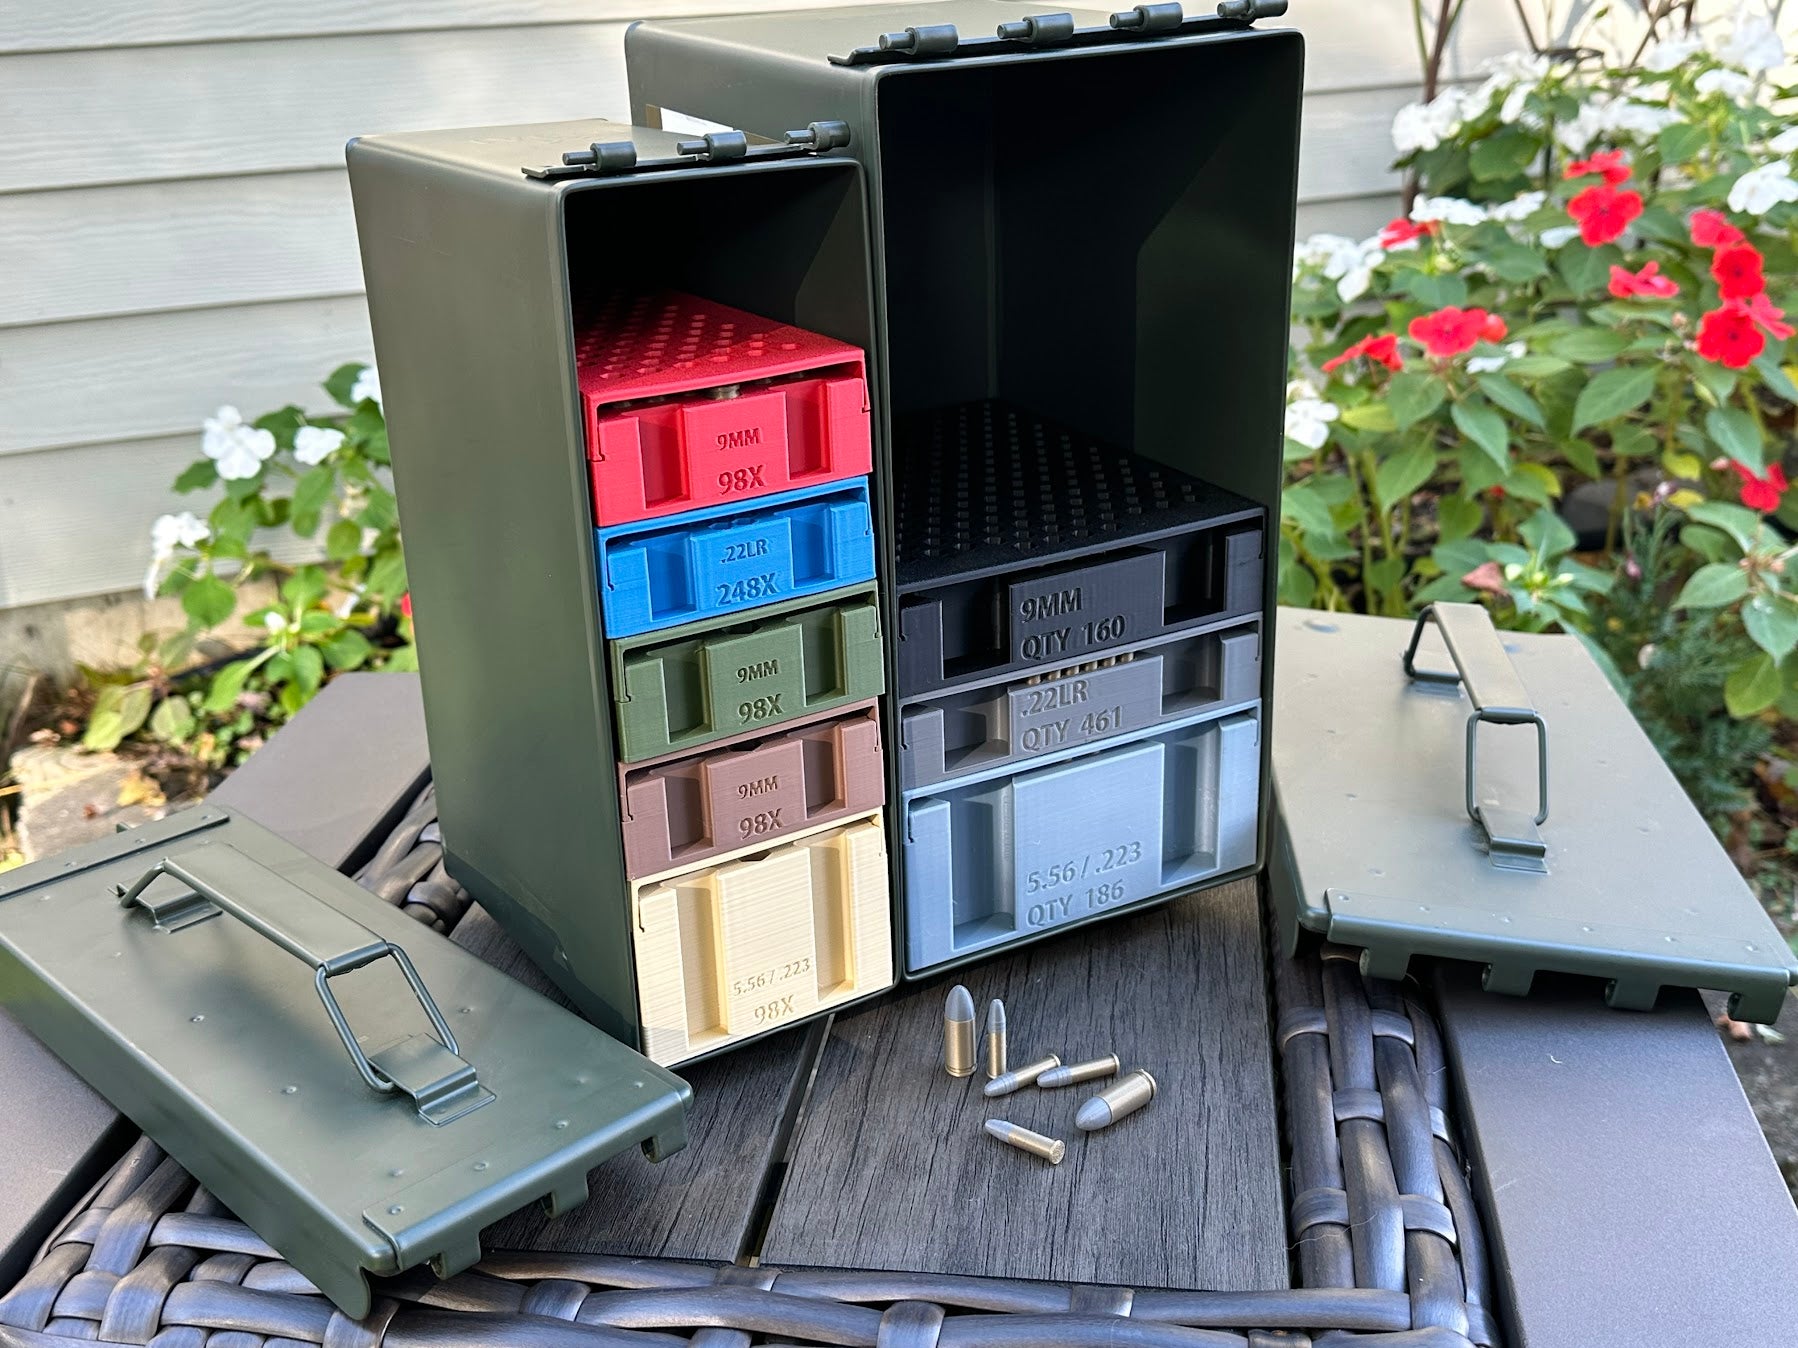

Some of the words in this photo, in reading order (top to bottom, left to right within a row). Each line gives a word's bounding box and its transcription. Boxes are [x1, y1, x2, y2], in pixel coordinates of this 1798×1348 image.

[717, 428, 760, 450] 9MM
[718, 465, 766, 495] 98X
[721, 539, 768, 564] .22LR
[716, 572, 778, 607] 248X
[1021, 587, 1082, 623] 9MM
[1021, 627, 1071, 660] QTY
[1082, 615, 1126, 645] 160
[737, 659, 778, 683] 9MM
[738, 693, 783, 725] 98X
[1021, 680, 1089, 717] .22LR
[1022, 719, 1070, 752] QTY
[1081, 706, 1122, 735] 461
[738, 776, 778, 799] 9MM
[739, 808, 783, 839] 98X
[1027, 861, 1076, 894] 5.56
[1096, 841, 1141, 873] .223
[1028, 894, 1073, 926] QTY
[1086, 879, 1124, 908] 186
[754, 994, 794, 1025] 98X
